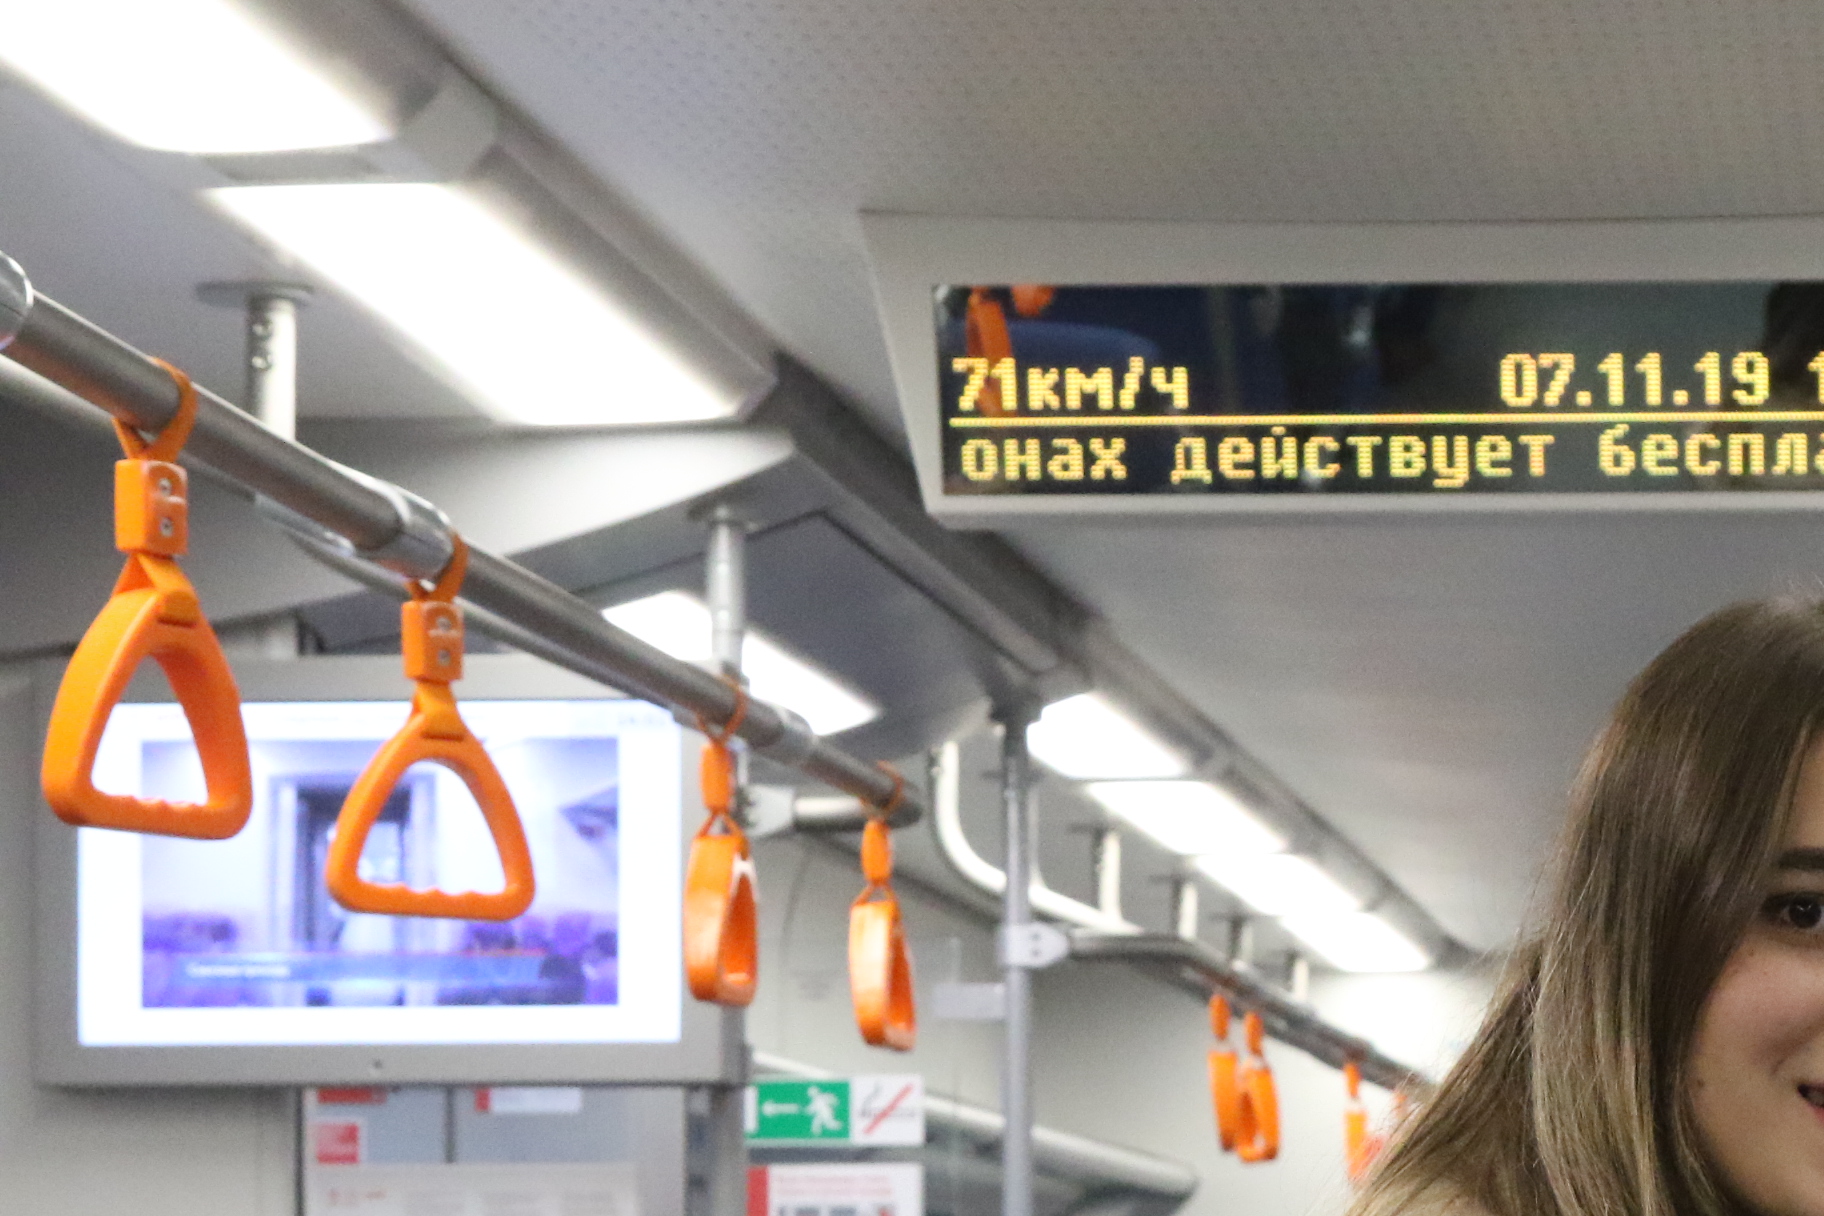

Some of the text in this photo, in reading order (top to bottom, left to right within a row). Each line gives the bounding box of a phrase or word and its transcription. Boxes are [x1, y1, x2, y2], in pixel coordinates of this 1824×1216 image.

[952, 356, 1190, 412] 71км/ч
[1500, 351, 1770, 408] 07.11.19
[961, 438, 1128, 481] онах
[1171, 425, 1555, 489] действует
